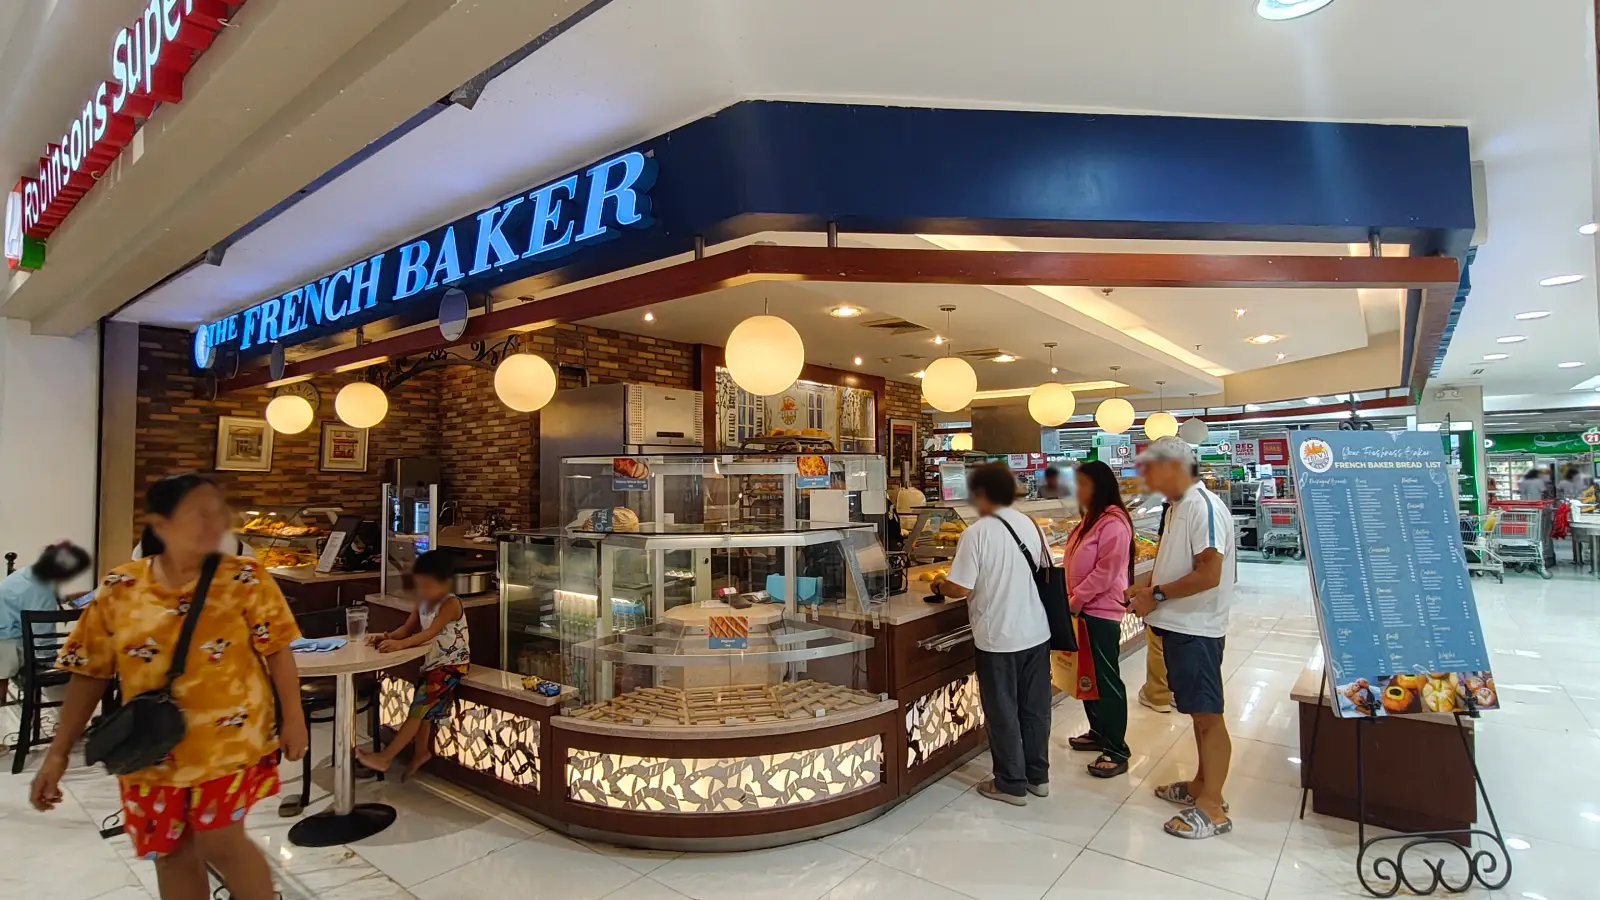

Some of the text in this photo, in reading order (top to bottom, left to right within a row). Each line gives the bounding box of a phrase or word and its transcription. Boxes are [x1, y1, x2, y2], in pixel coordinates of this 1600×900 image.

[24, 0, 194, 233] Robinsons Supe
[207, 151, 645, 350] THE FRENCH BAKER
[1425, 461, 1441, 469] LIST
[1586, 434, 1599, 442] 21
